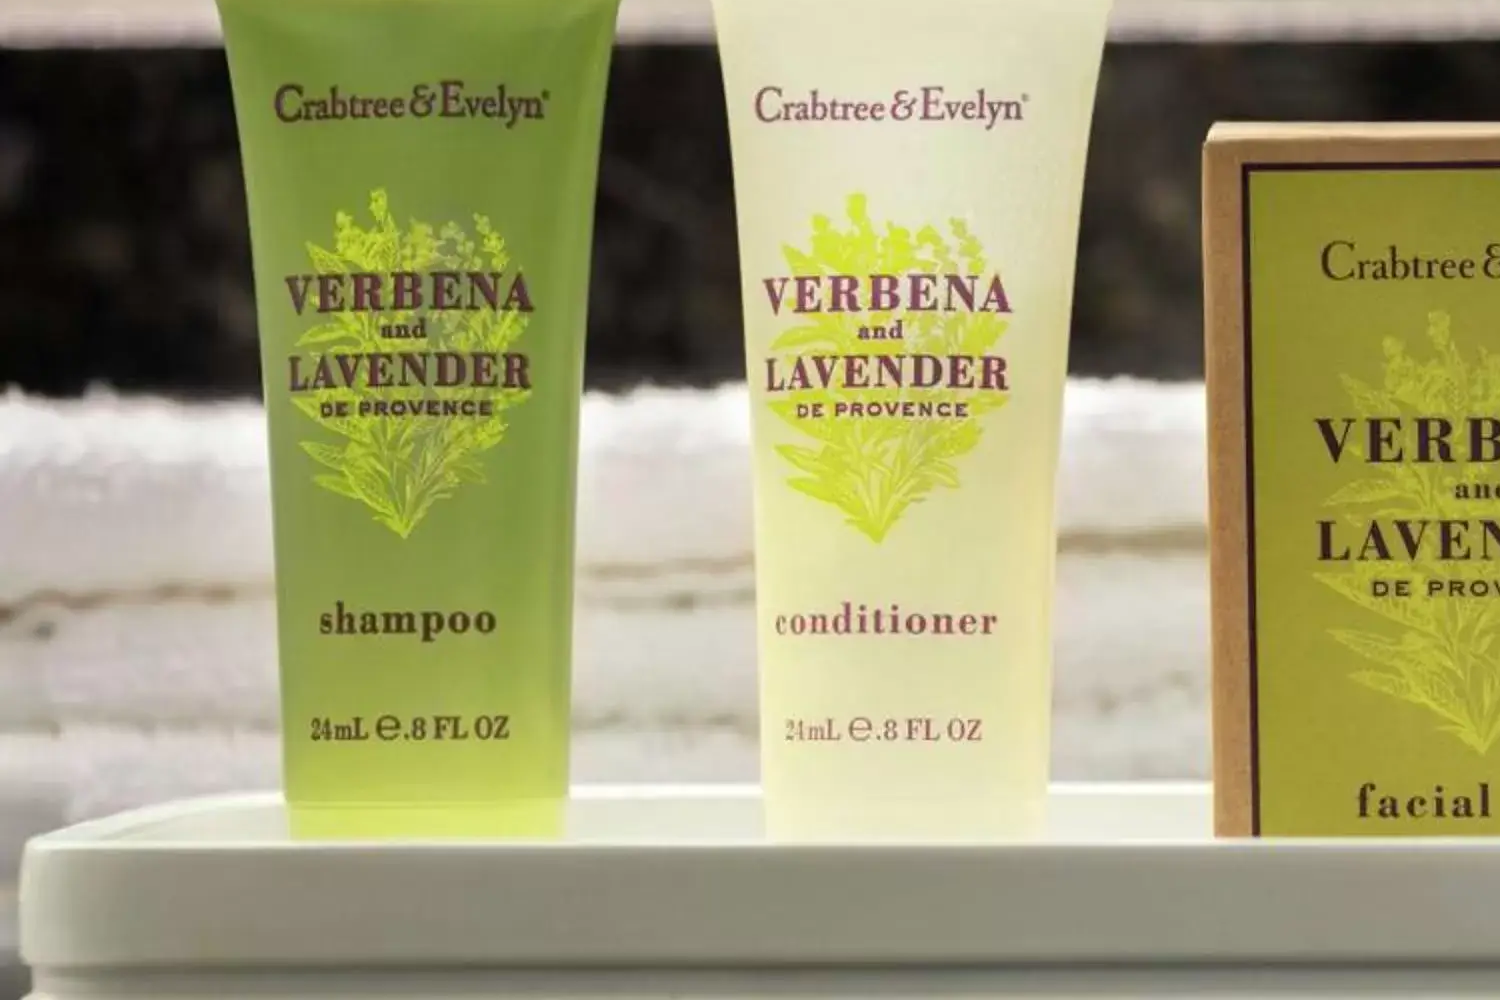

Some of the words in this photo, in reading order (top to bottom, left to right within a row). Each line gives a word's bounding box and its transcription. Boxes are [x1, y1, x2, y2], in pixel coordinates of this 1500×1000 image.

[274, 84, 405, 123] Crabtree
[754, 87, 885, 123] Crabtree
[1320, 240, 1475, 280] Crabtree
[284, 271, 535, 315] VERBENA
[762, 273, 1013, 316] VERBENA
[380, 317, 427, 339] and
[857, 320, 904, 340] and
[288, 352, 533, 392] LAVENDER
[765, 354, 1009, 392] LAVENDER
[320, 401, 348, 418] DE
[359, 400, 493, 416] PROVENCE
[797, 403, 824, 418] DE
[835, 402, 968, 417] PROVENCE
[1372, 581, 1410, 597] DE
[319, 600, 497, 642] shampoo
[775, 602, 998, 635] conditioner
[310, 717, 368, 741] 24mL
[433, 716, 468, 739] FL
[474, 715, 510, 739] OZ
[785, 718, 840, 741] 24mL
[905, 719, 939, 740] FL
[947, 719, 983, 741] OZ
[1357, 782, 1491, 818] facial
